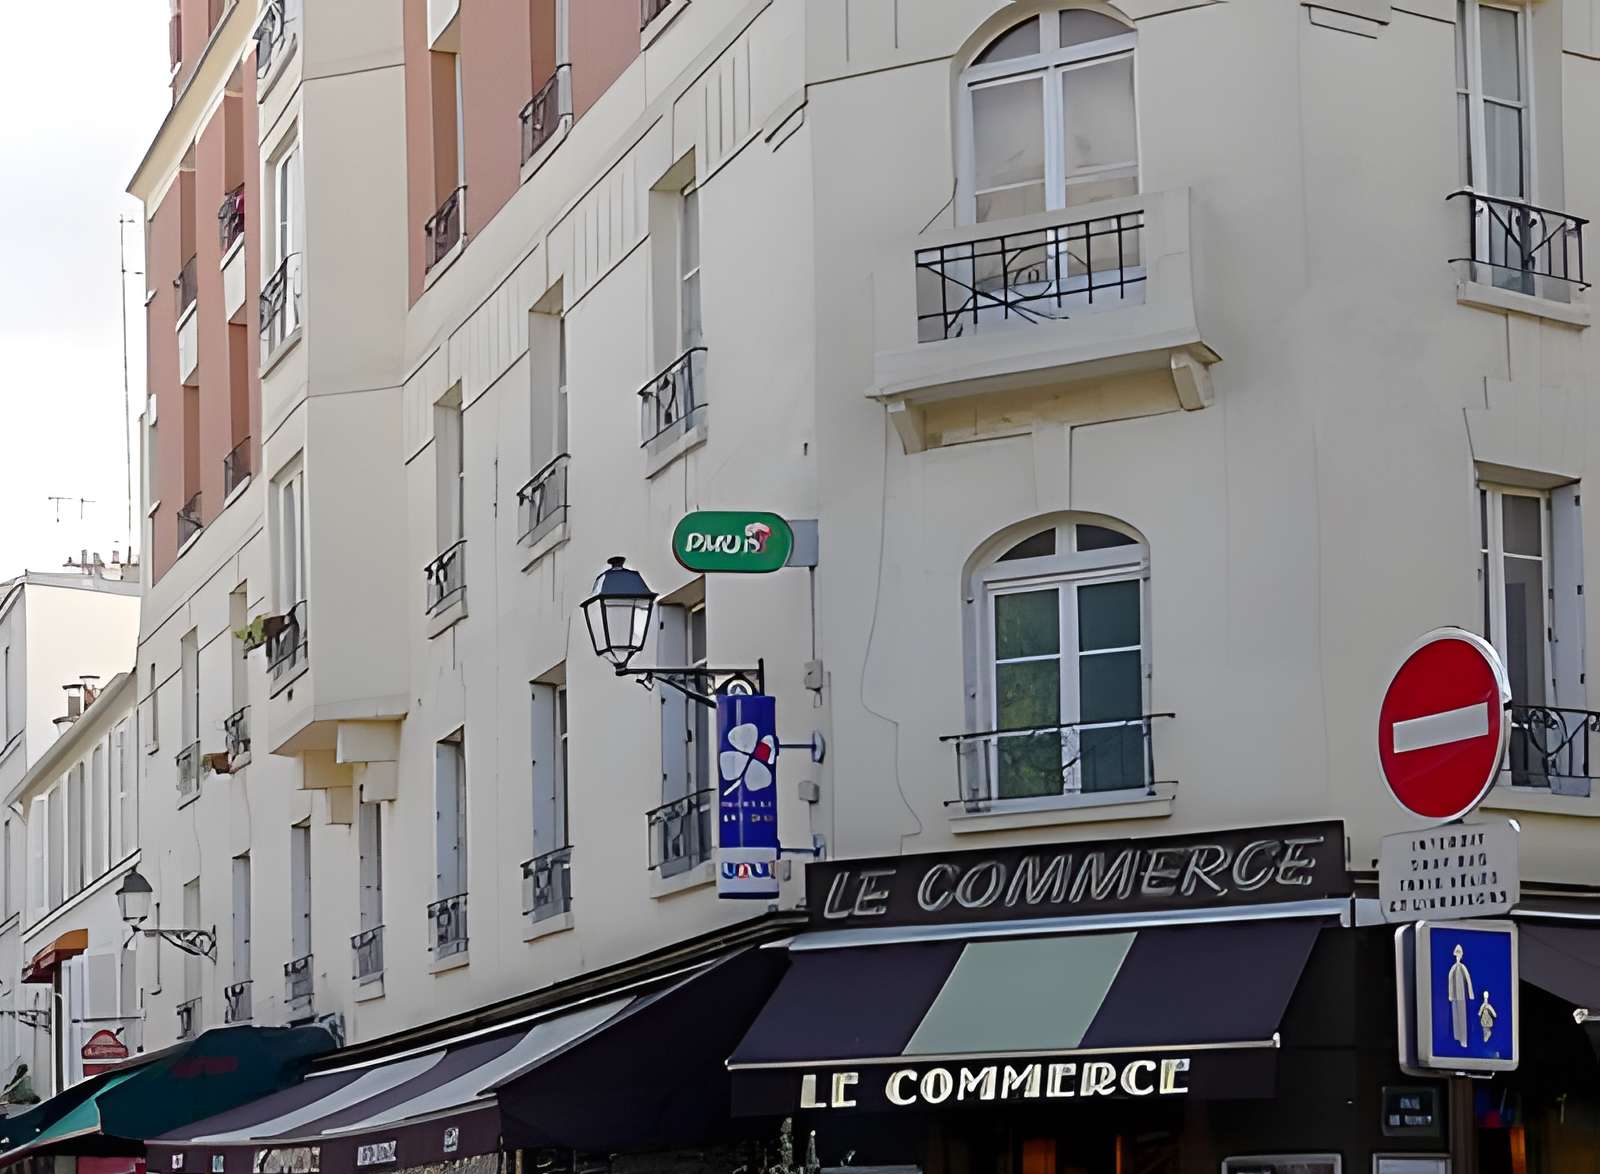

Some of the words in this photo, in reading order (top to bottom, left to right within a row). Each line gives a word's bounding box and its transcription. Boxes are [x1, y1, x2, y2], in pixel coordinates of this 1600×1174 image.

[823, 869, 896, 919] LE
[917, 835, 1325, 913] COMMERCE
[800, 1071, 859, 1109] LE
[885, 1057, 1192, 1107] COMMERCE
